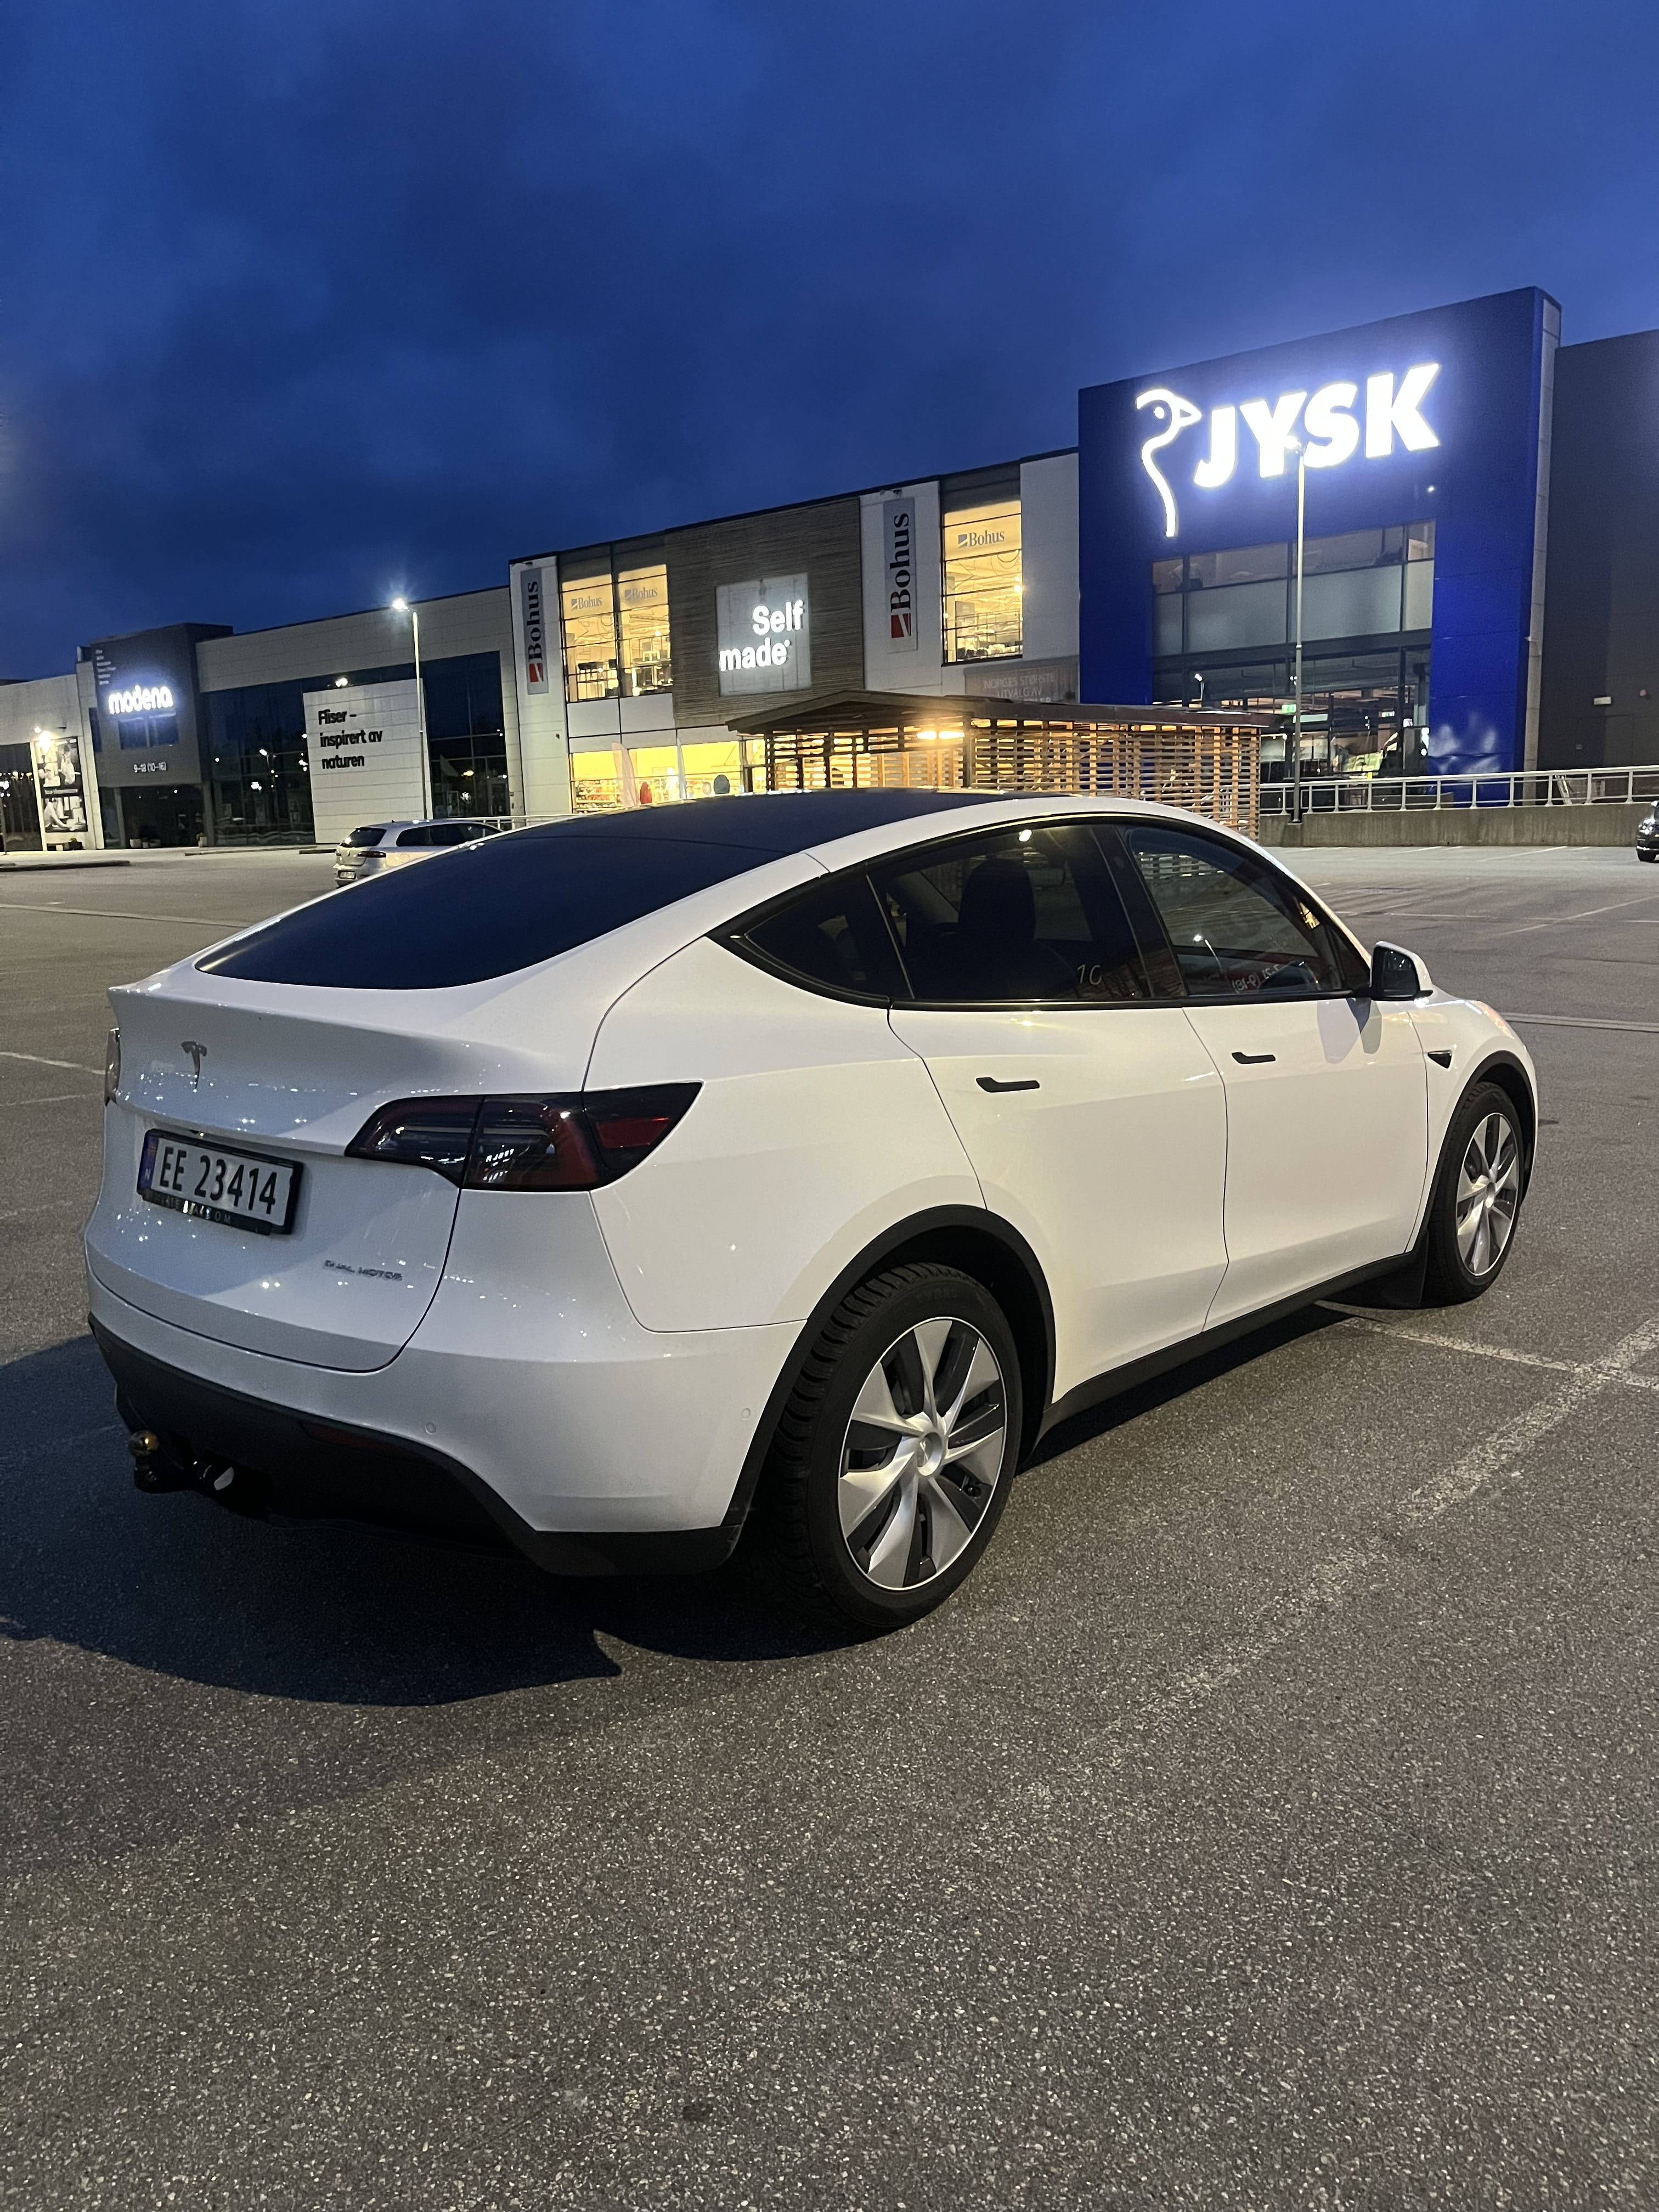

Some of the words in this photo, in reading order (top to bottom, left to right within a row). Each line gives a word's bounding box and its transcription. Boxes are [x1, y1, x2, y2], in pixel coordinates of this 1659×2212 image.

[1194, 363, 1440, 488] JYSK
[969, 530, 1005, 546] Bohus
[890, 514, 911, 612] Bohus
[578, 596, 602, 609] Bohus
[632, 587, 657, 600] Bohus
[527, 581, 542, 662] Bohus
[753, 600, 804, 635] Self
[109, 685, 173, 714] modena
[318, 709, 347, 725] Fliser
[319, 729, 366, 749] inspirert
[368, 730, 382, 742] av
[321, 755, 364, 769] naturen
[144, 1167, 151, 1181] N
[160, 1147, 187, 1191] EE
[194, 1155, 277, 1215] 23414
